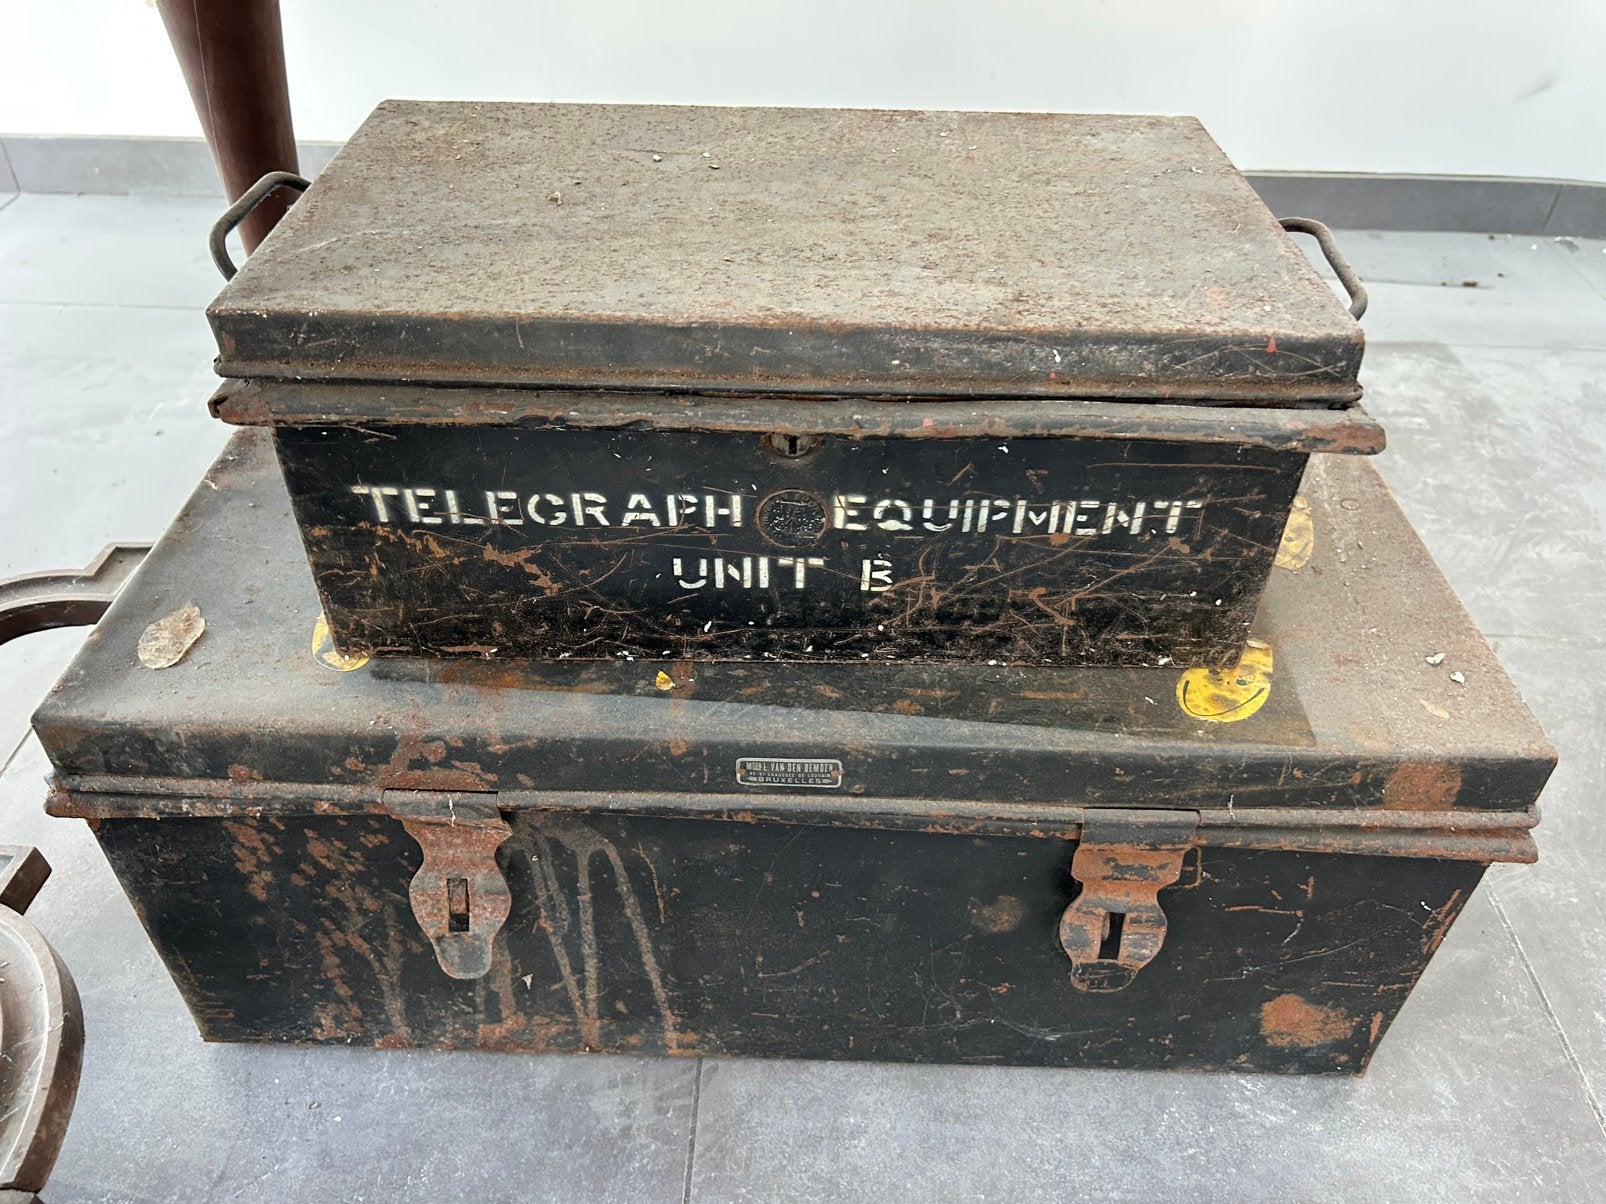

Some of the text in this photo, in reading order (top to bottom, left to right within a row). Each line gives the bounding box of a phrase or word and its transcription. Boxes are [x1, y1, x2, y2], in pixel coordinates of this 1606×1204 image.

[352, 486, 742, 527] TELEGRAPH
[833, 495, 1203, 536] EQUIPMENT
[673, 557, 893, 592] UNIT B
[770, 762, 785, 772] VAN
[787, 763, 801, 773] DEN
[804, 763, 833, 773] BEMDEN
[758, 776, 822, 784] BRUXELLES
